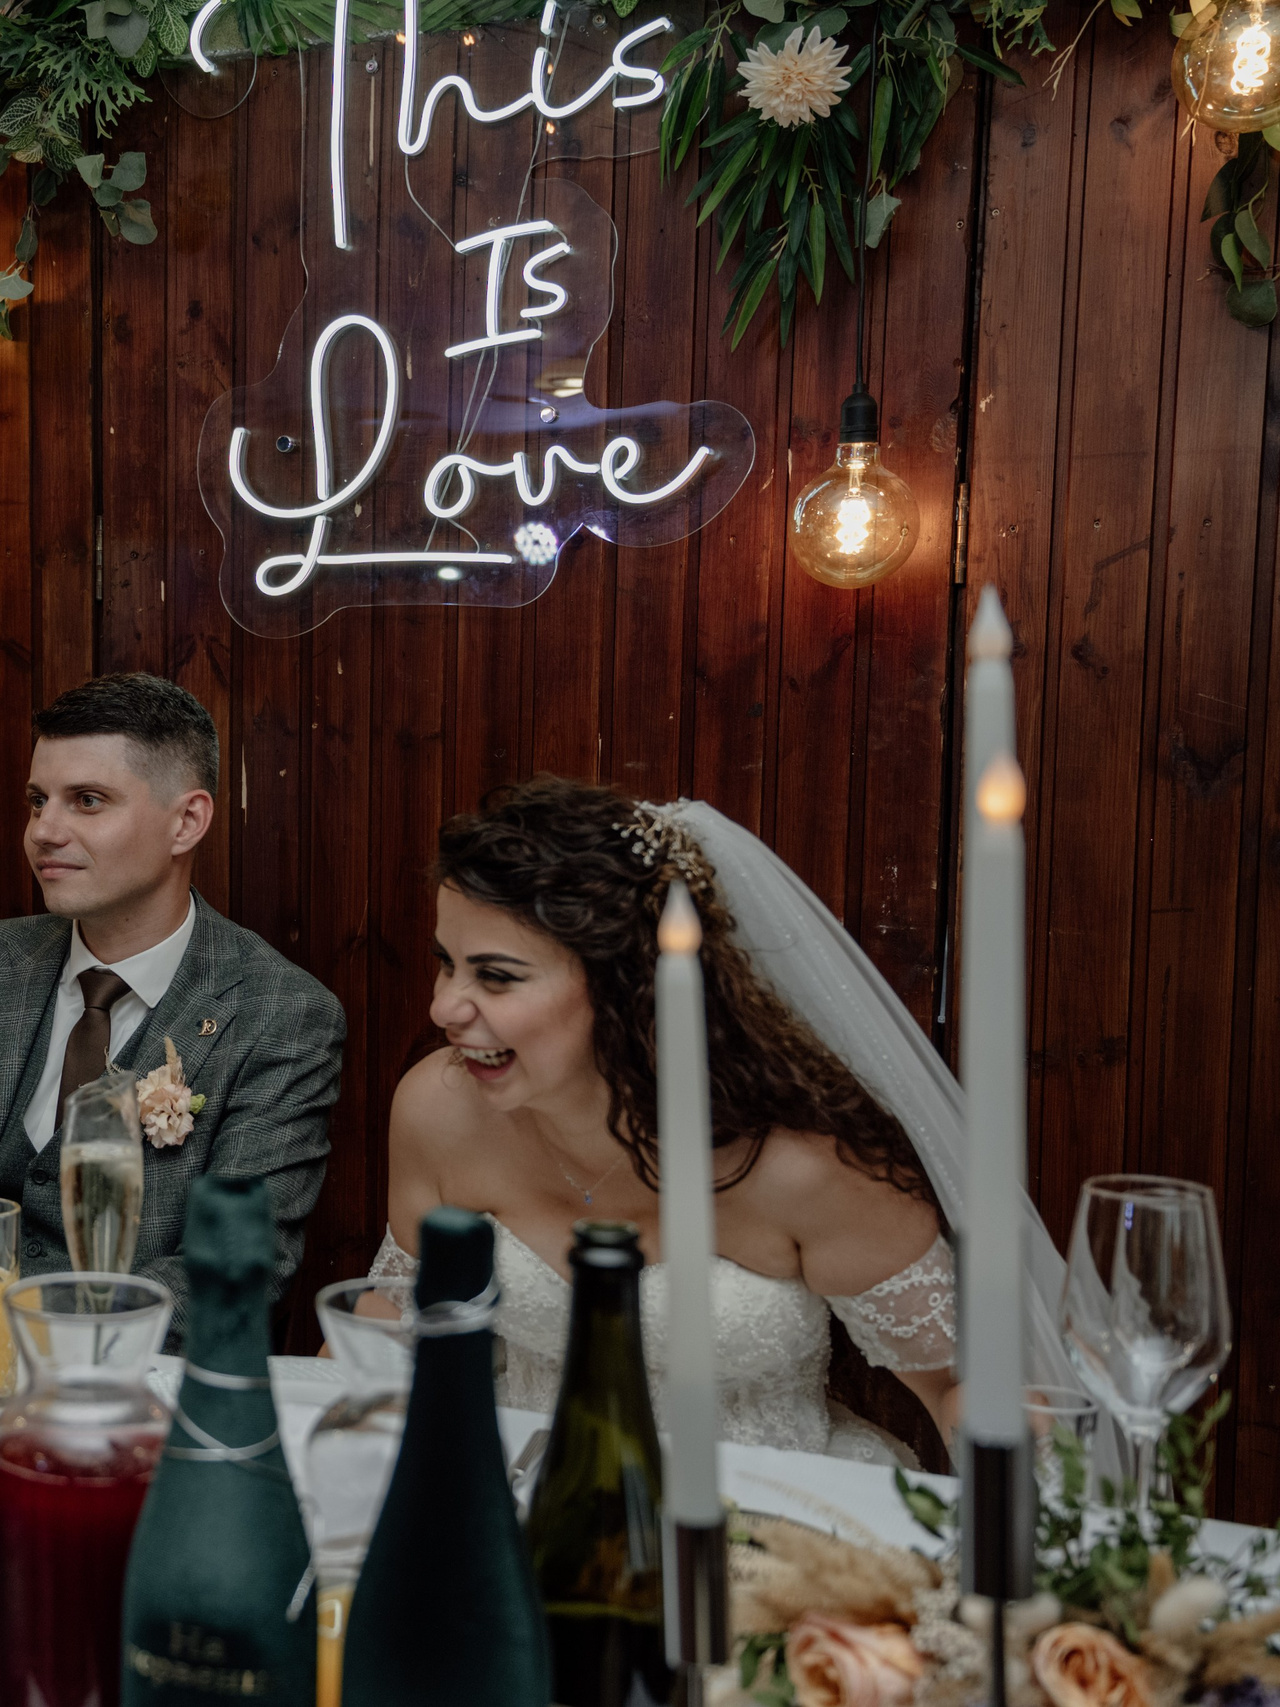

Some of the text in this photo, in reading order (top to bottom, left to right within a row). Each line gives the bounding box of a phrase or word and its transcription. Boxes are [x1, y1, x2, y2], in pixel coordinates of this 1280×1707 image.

[191, 0, 671, 249] This
[444, 219, 570, 360] Is
[229, 314, 713, 597] Love
